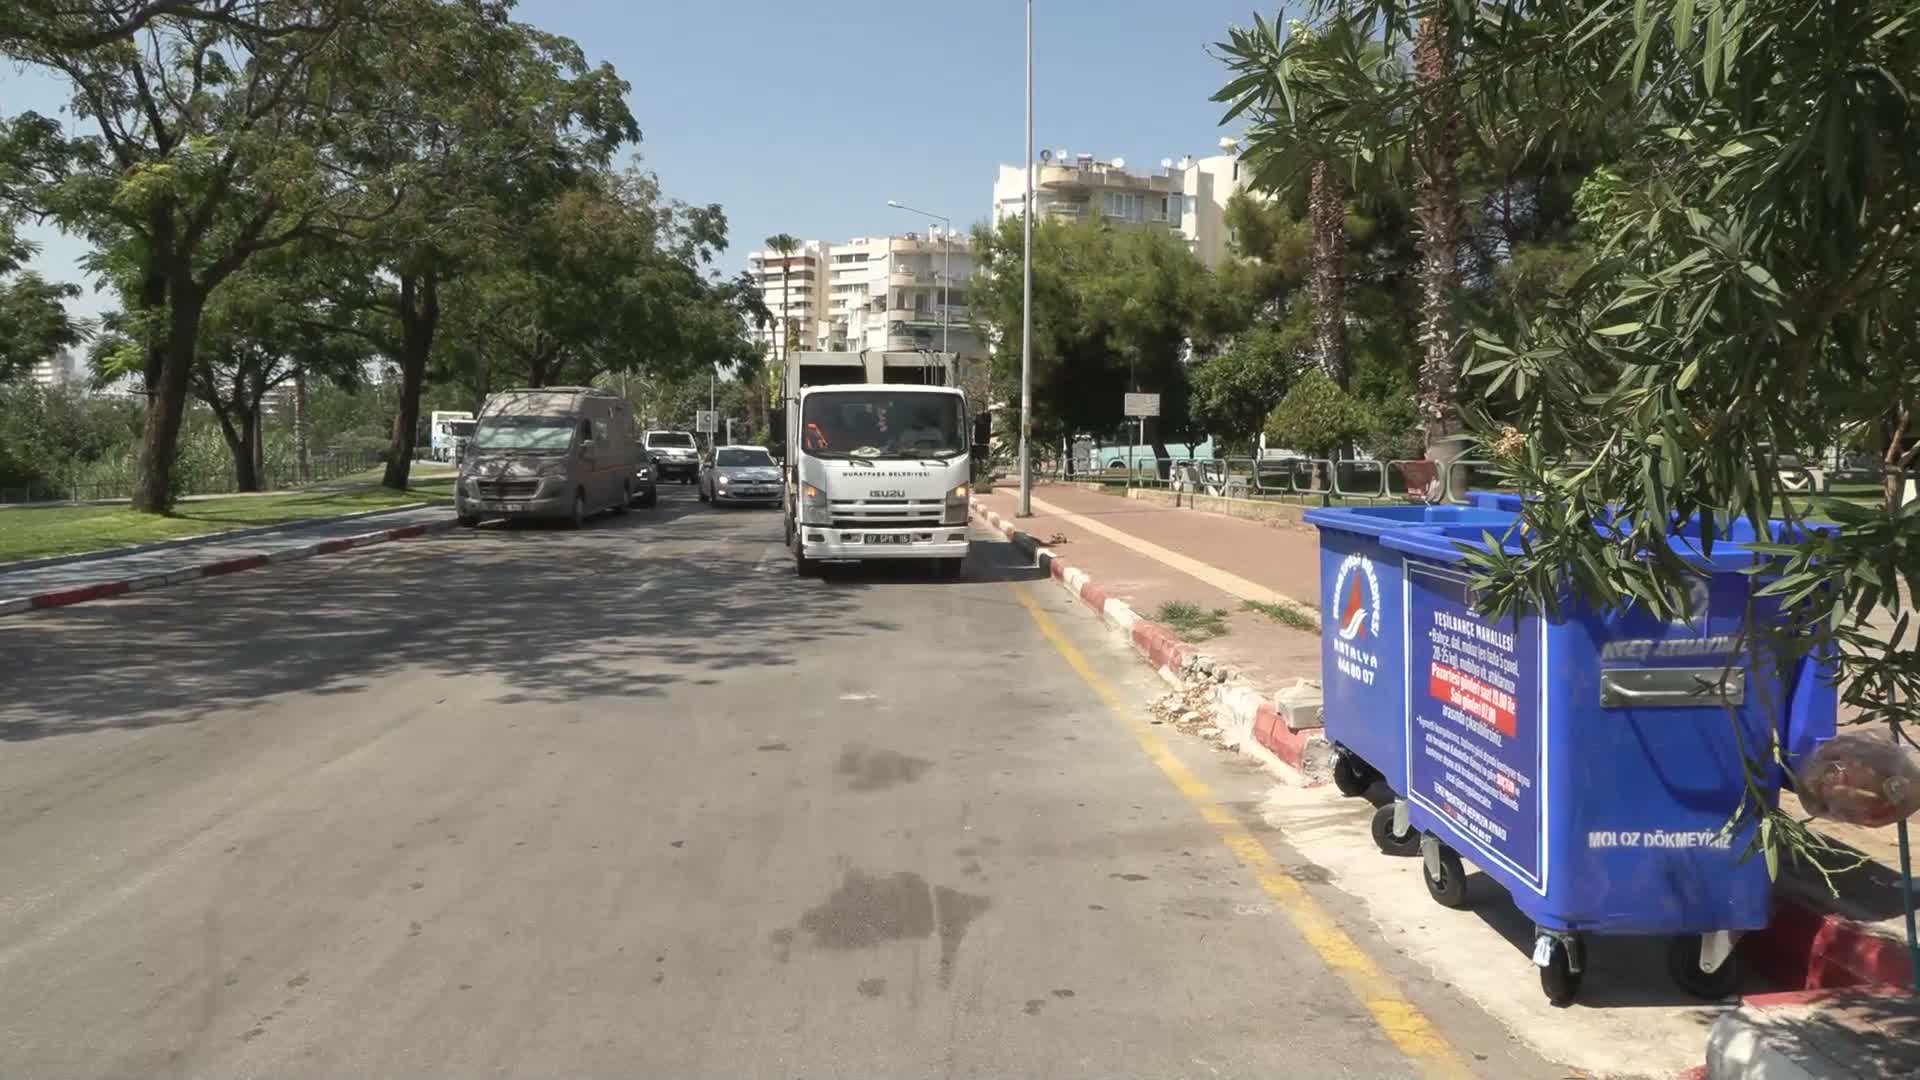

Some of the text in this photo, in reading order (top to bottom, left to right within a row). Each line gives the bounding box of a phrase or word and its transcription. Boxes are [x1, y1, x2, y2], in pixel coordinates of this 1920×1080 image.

[869, 489, 906, 498] ISUZU
[1434, 610, 1513, 652] YEŞİLBAHÇE MAHALLESİ
[1333, 638, 1378, 669] ANTALYA
[1350, 662, 1362, 681] 80
[1362, 667, 1375, 686] 07
[1431, 662, 1459, 685] Pazartesi
[1480, 684, 1491, 700] saat
